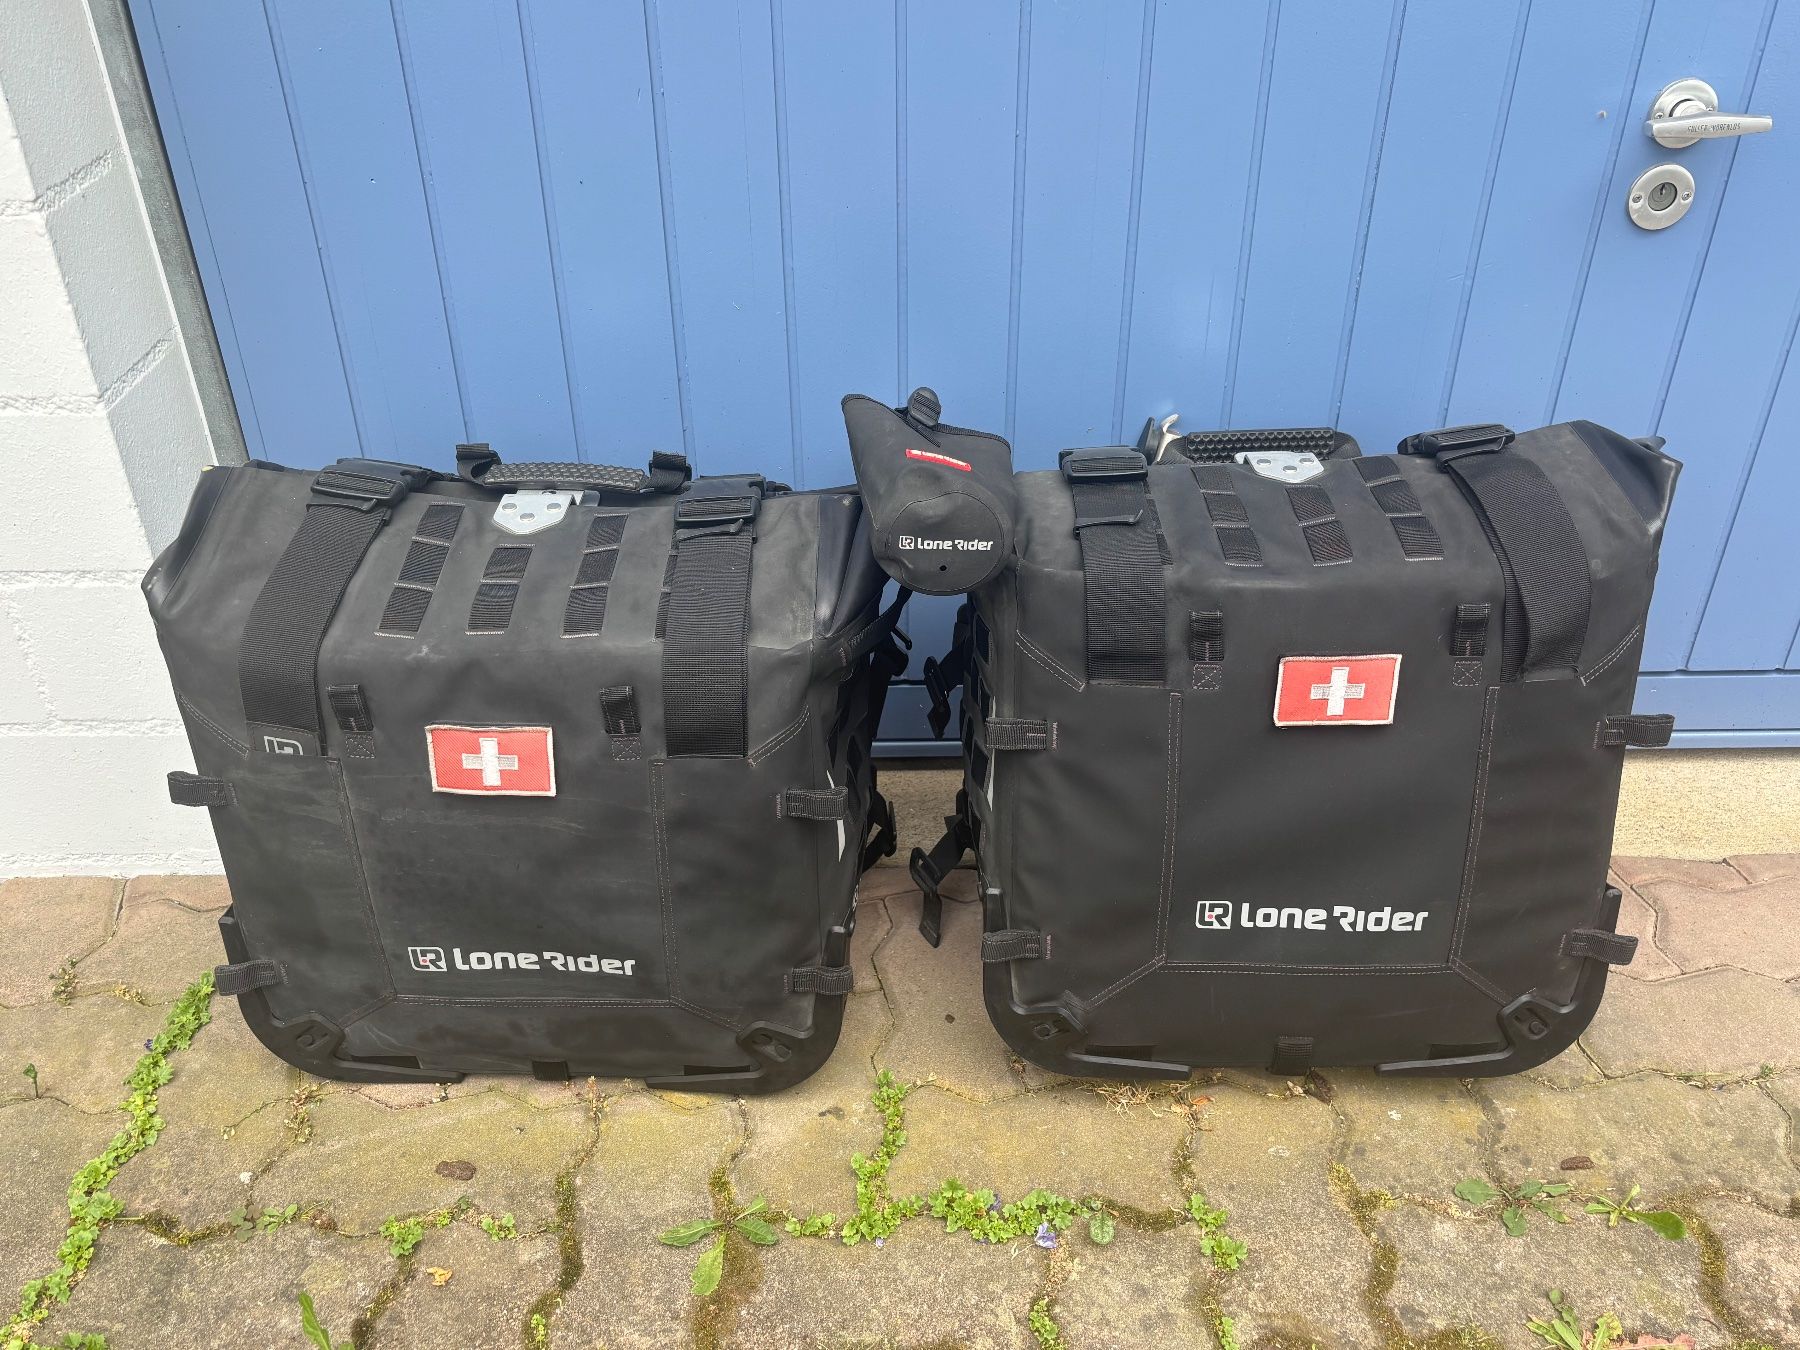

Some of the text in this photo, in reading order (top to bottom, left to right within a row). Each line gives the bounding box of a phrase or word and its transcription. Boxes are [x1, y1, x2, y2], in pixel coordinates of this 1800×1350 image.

[918, 537, 953, 550] Lone
[955, 538, 994, 551] Rider
[1241, 902, 1328, 930] Lone
[1332, 906, 1429, 932] Rider
[452, 947, 541, 971] Lone
[543, 951, 636, 976] Rider
